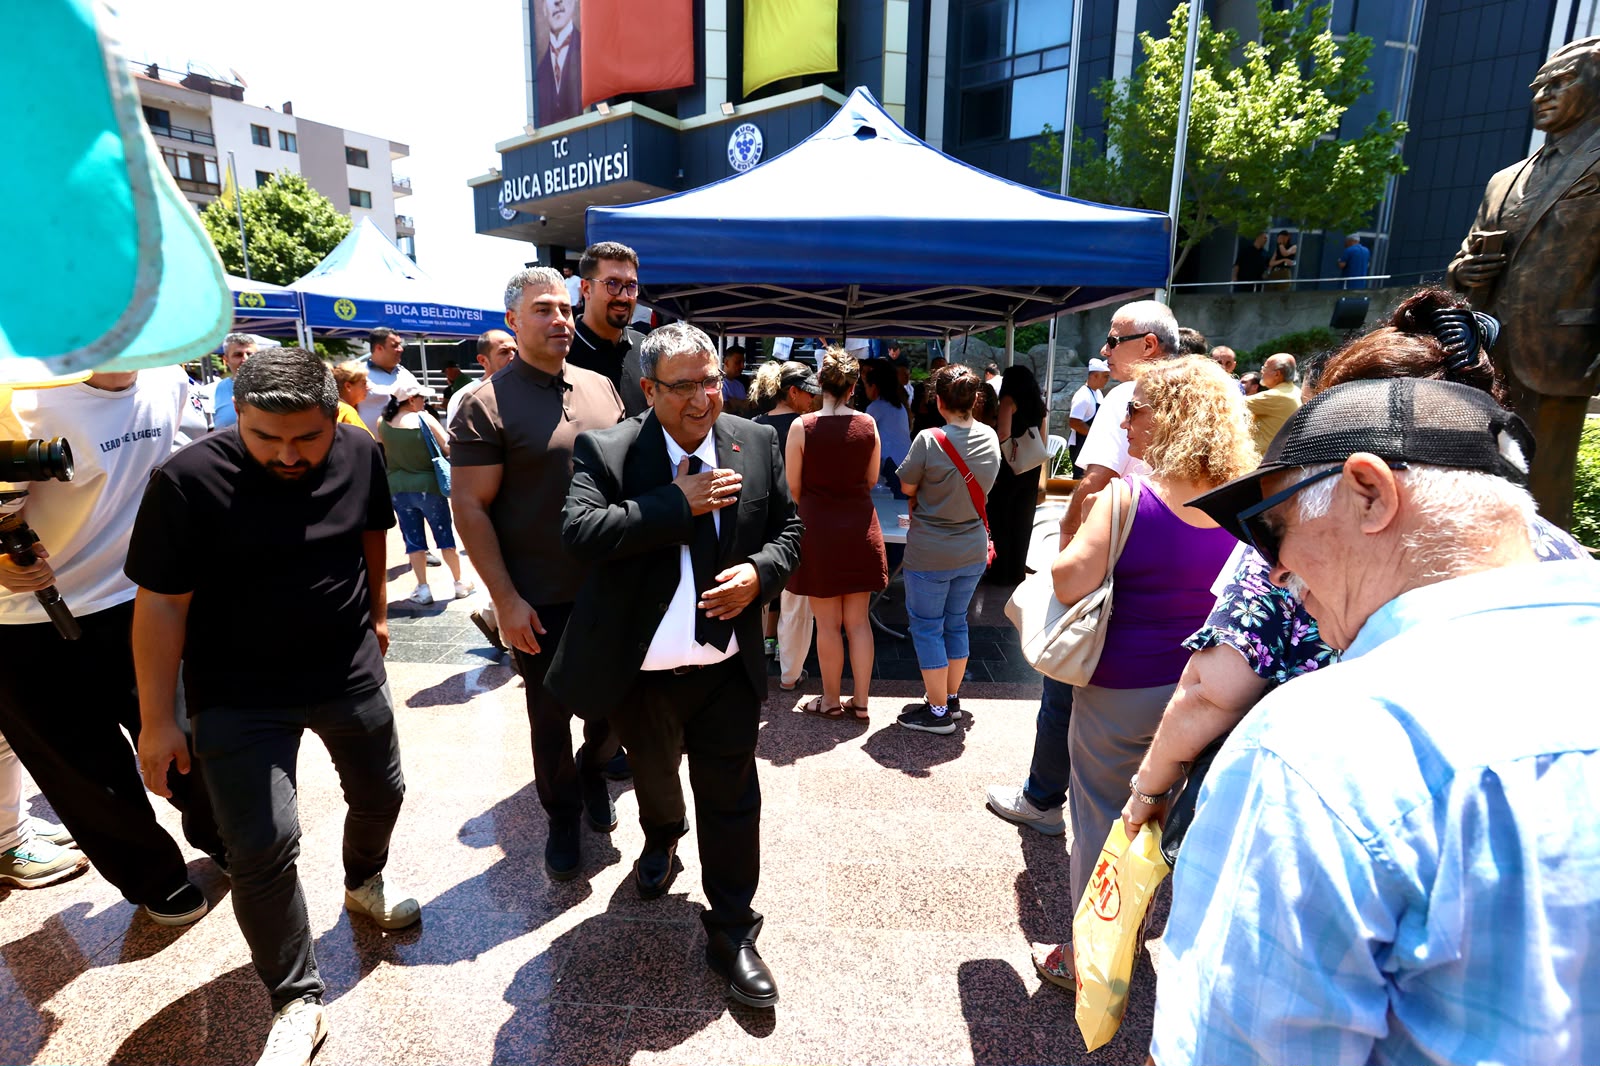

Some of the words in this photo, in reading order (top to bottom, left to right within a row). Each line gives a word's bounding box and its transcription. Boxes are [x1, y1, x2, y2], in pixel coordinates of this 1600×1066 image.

[735, 126, 755, 137] BUCA
[552, 137, 568, 158] T.C
[504, 173, 542, 203] BUCA
[544, 143, 628, 194] BELEDİYESİ
[385, 304, 419, 316] BUCA
[421, 307, 483, 321] BELEDİYESİ
[100, 438, 121, 453] LEAD
[132, 427, 162, 441] LEAGUE
